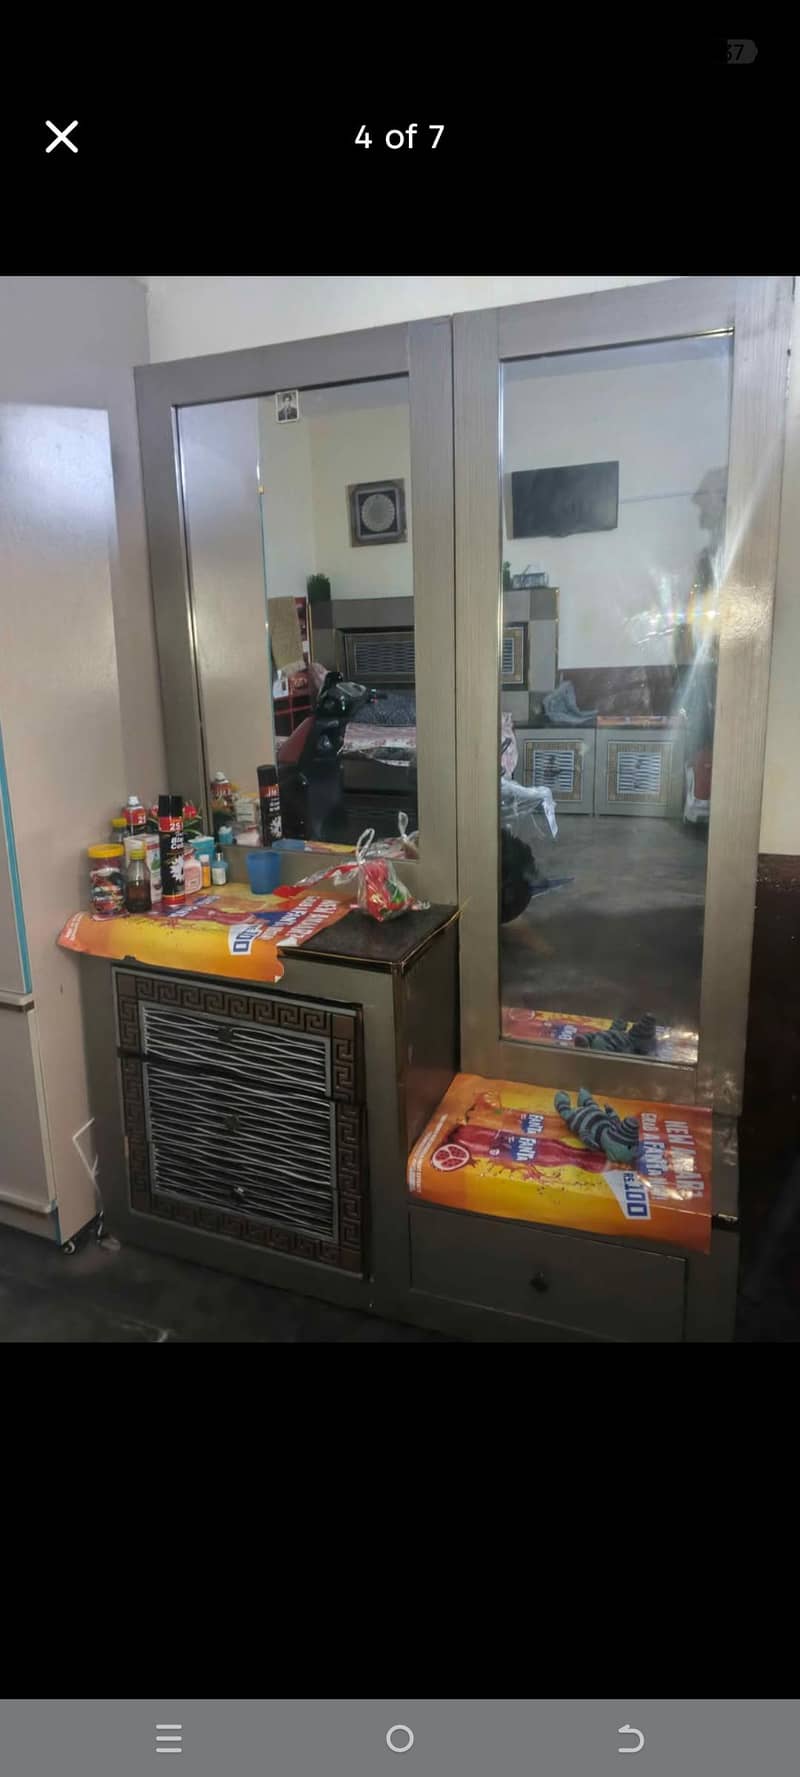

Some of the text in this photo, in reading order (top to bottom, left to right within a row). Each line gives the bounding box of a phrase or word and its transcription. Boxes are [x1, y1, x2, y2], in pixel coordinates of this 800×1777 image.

[354, 122, 445, 149] 4 of 7
[664, 1120, 695, 1146] NEW
[516, 1137, 537, 1161] FANTA
[643, 1141, 669, 1176] FANTA
